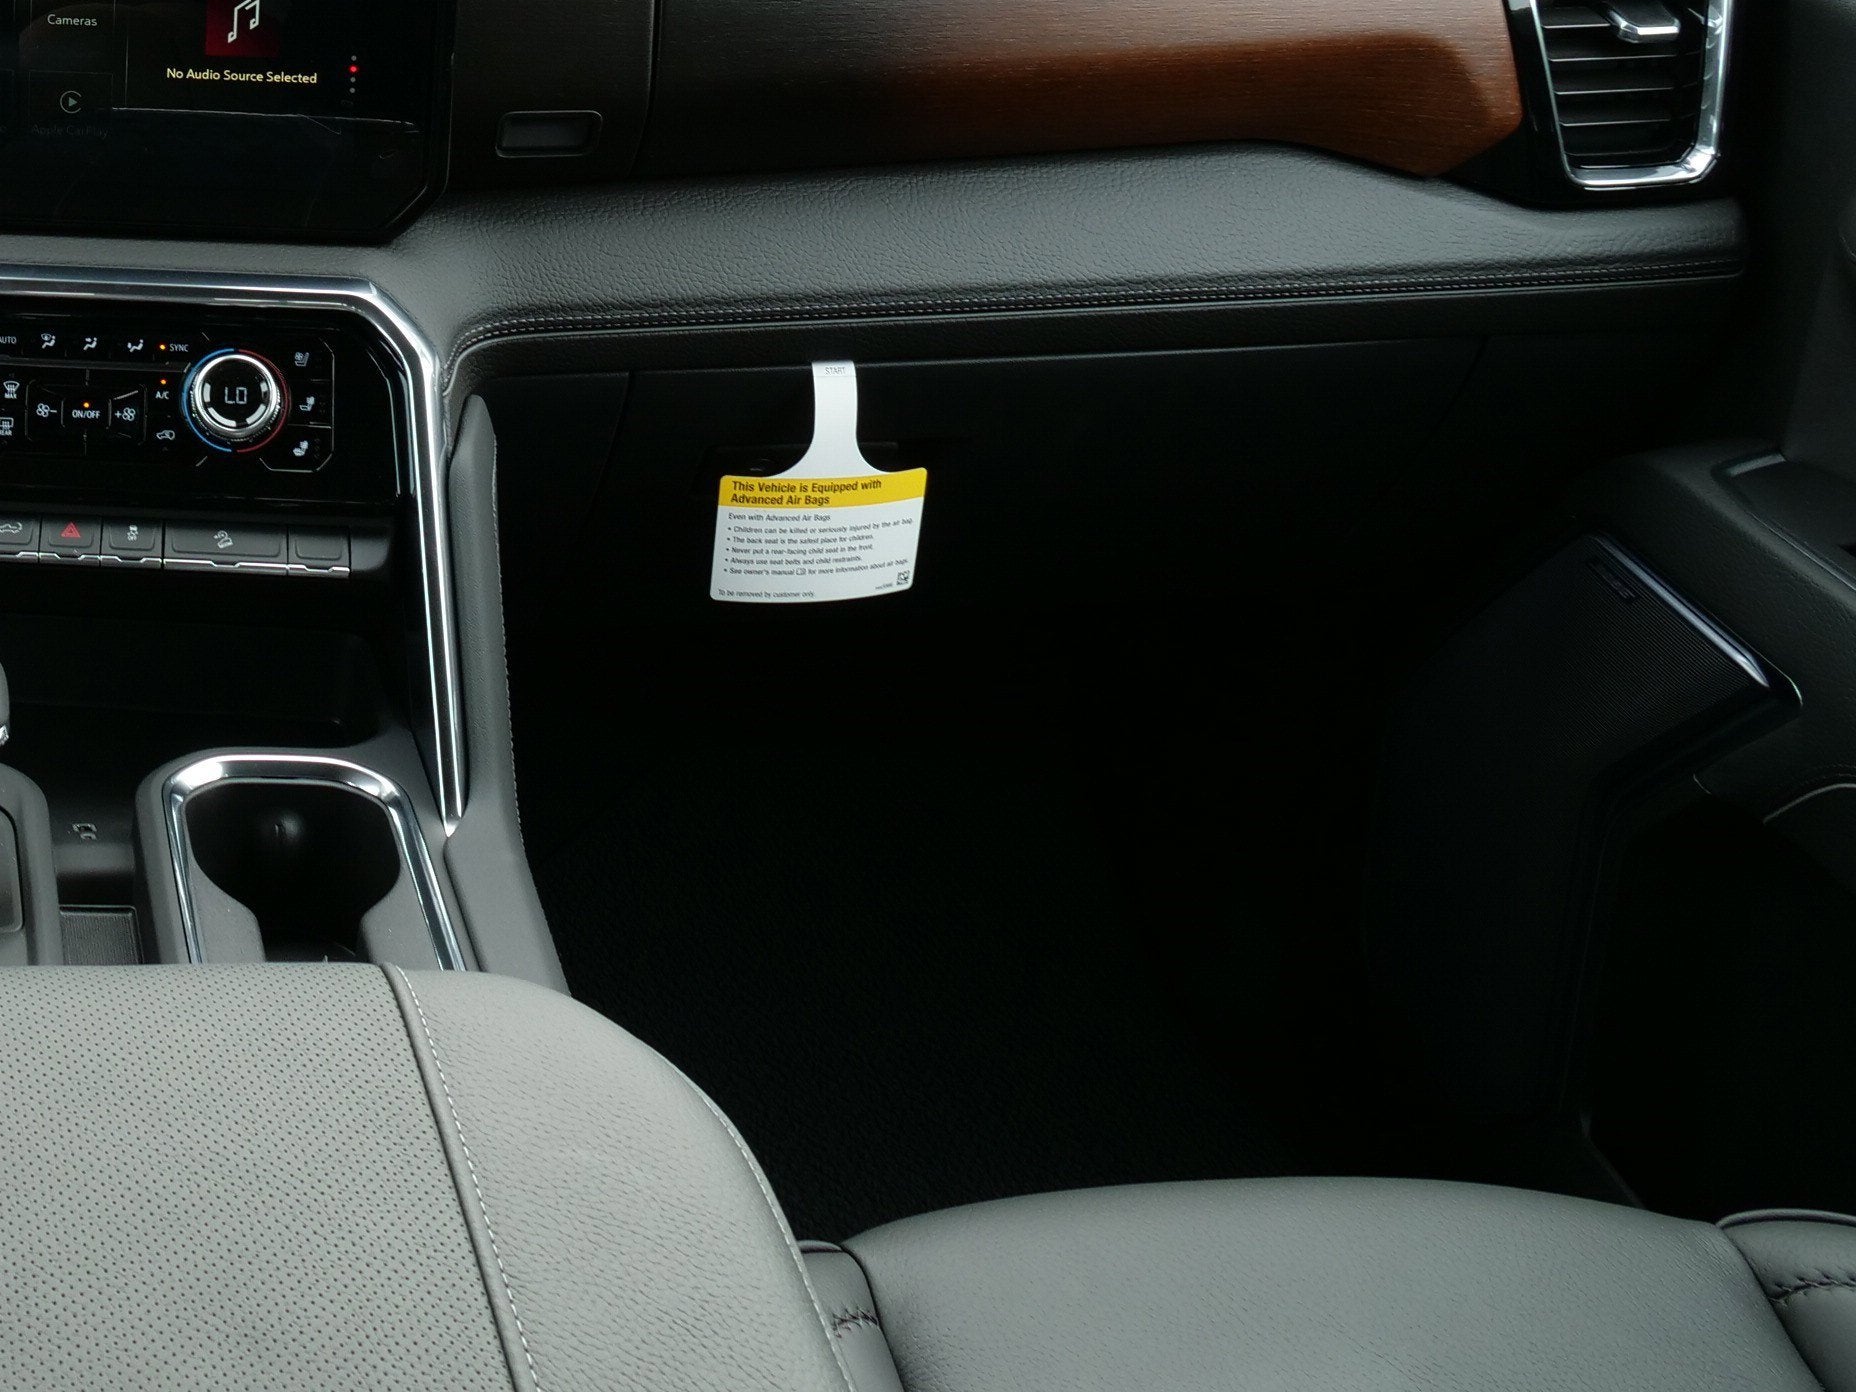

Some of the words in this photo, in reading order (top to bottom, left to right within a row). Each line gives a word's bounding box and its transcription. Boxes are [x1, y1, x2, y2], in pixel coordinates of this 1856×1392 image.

[47, 14, 98, 26] Cameras
[166, 68, 184, 79] No
[186, 69, 221, 80] Audio
[223, 69, 264, 82] Source
[266, 71, 318, 84] Selected
[169, 342, 190, 353] SYNC
[155, 390, 169, 400] A/C
[72, 409, 101, 420] ON/OFF
[732, 480, 755, 493] This
[757, 481, 796, 494] Vehicle
[799, 481, 809, 493] is
[811, 481, 859, 495] Equipped
[861, 479, 882, 491] with
[730, 493, 784, 506] Advanced
[786, 494, 801, 506] Air
[804, 495, 831, 507] Bags
[728, 512, 746, 521] Even
[748, 513, 764, 521] with
[765, 513, 801, 522] Advanced
[802, 513, 812, 522] Air
[814, 513, 831, 522] Bags
[733, 536, 745, 544] The
[731, 546, 751, 555] Never
